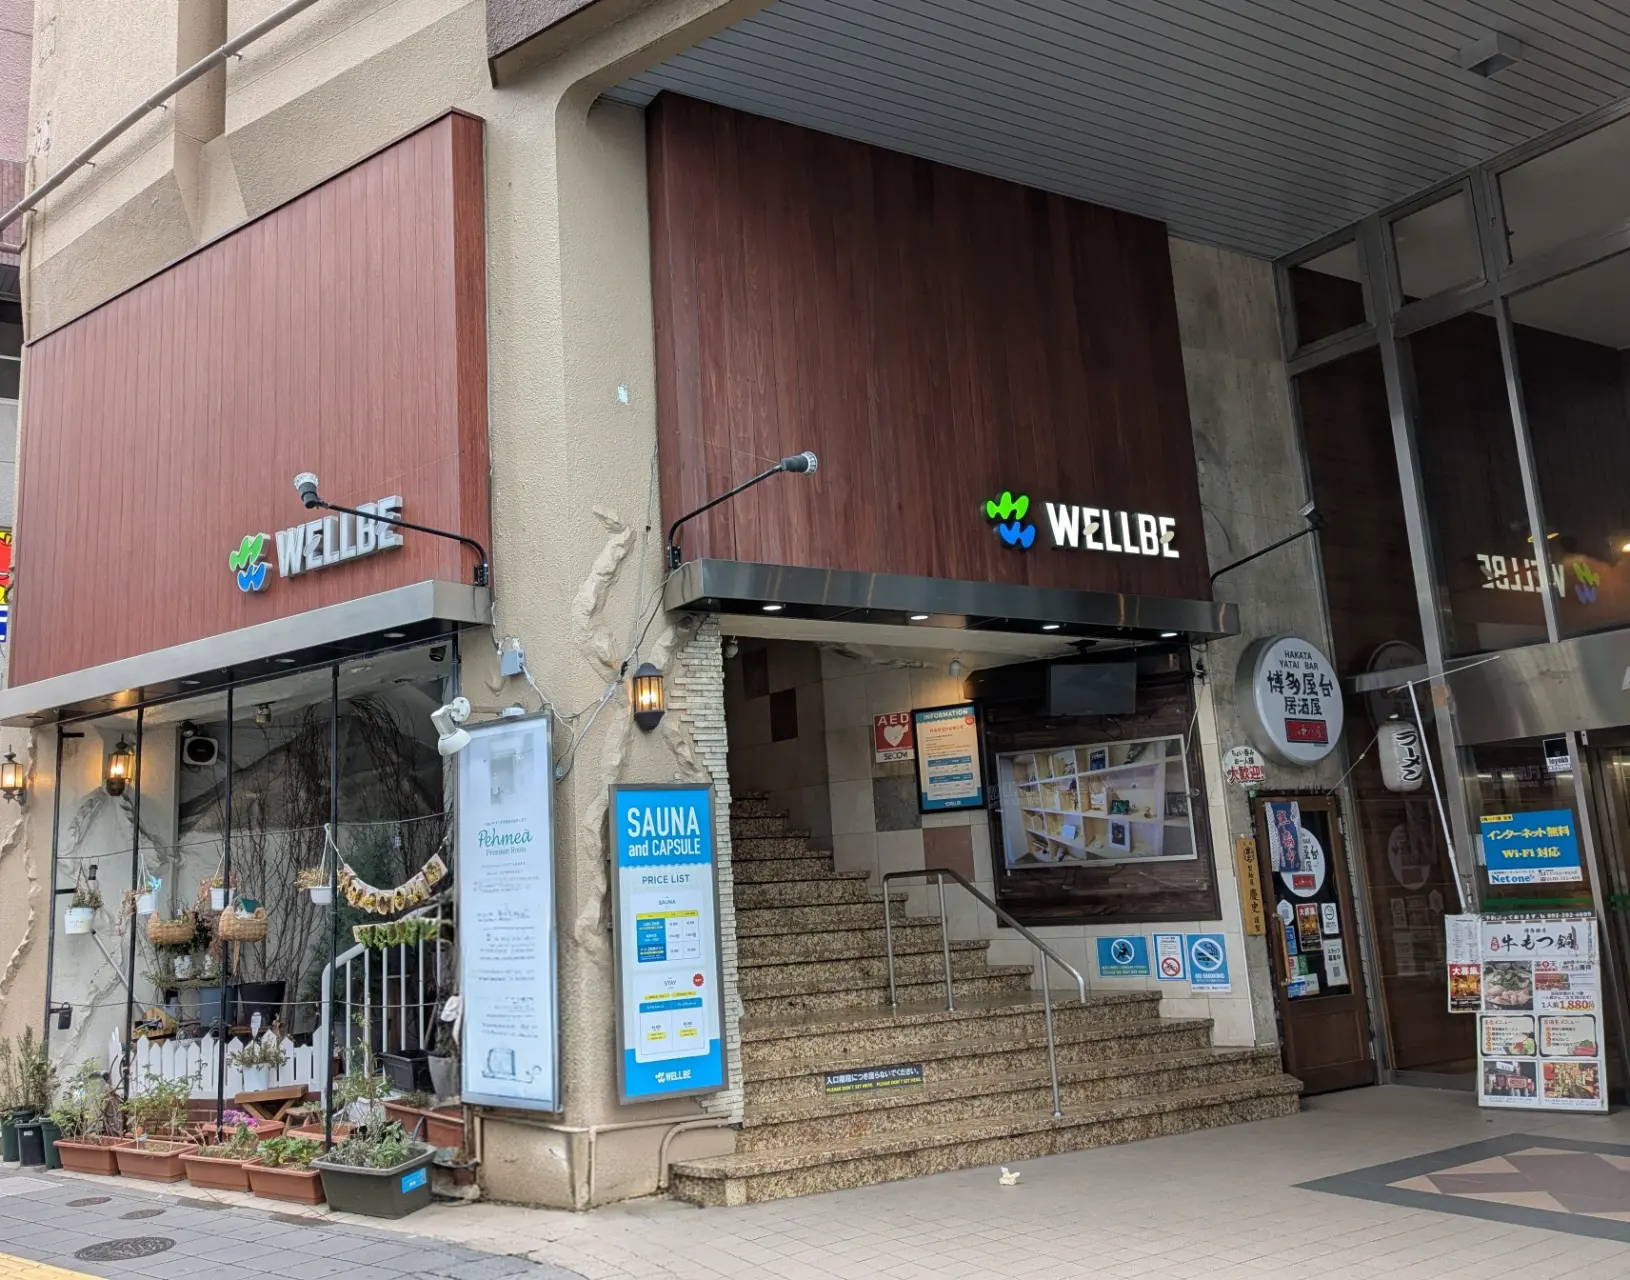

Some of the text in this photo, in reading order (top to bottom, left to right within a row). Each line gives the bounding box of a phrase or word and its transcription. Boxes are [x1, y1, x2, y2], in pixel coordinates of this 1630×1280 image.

[275, 495, 403, 578] WELLBE
[1045, 502, 1180, 558] WELLBE
[1279, 659, 1319, 671] YATAI BAR
[1284, 650, 1313, 661] HAKATA
[1267, 670, 1334, 698] 博多屋台
[923, 708, 969, 720] INFORMATION
[1284, 696, 1323, 716] 居酒屋
[877, 713, 909, 726] AED
[883, 751, 908, 761] SECOM
[1396, 729, 1422, 782] ラーメン
[627, 806, 700, 838] SAUNA
[628, 838, 701, 857] and CAPSULE
[1537, 846, 1561, 859] 対応
[642, 873, 691, 885] PRICE LIST
[1501, 929, 1577, 952] 牛もつ鍋
